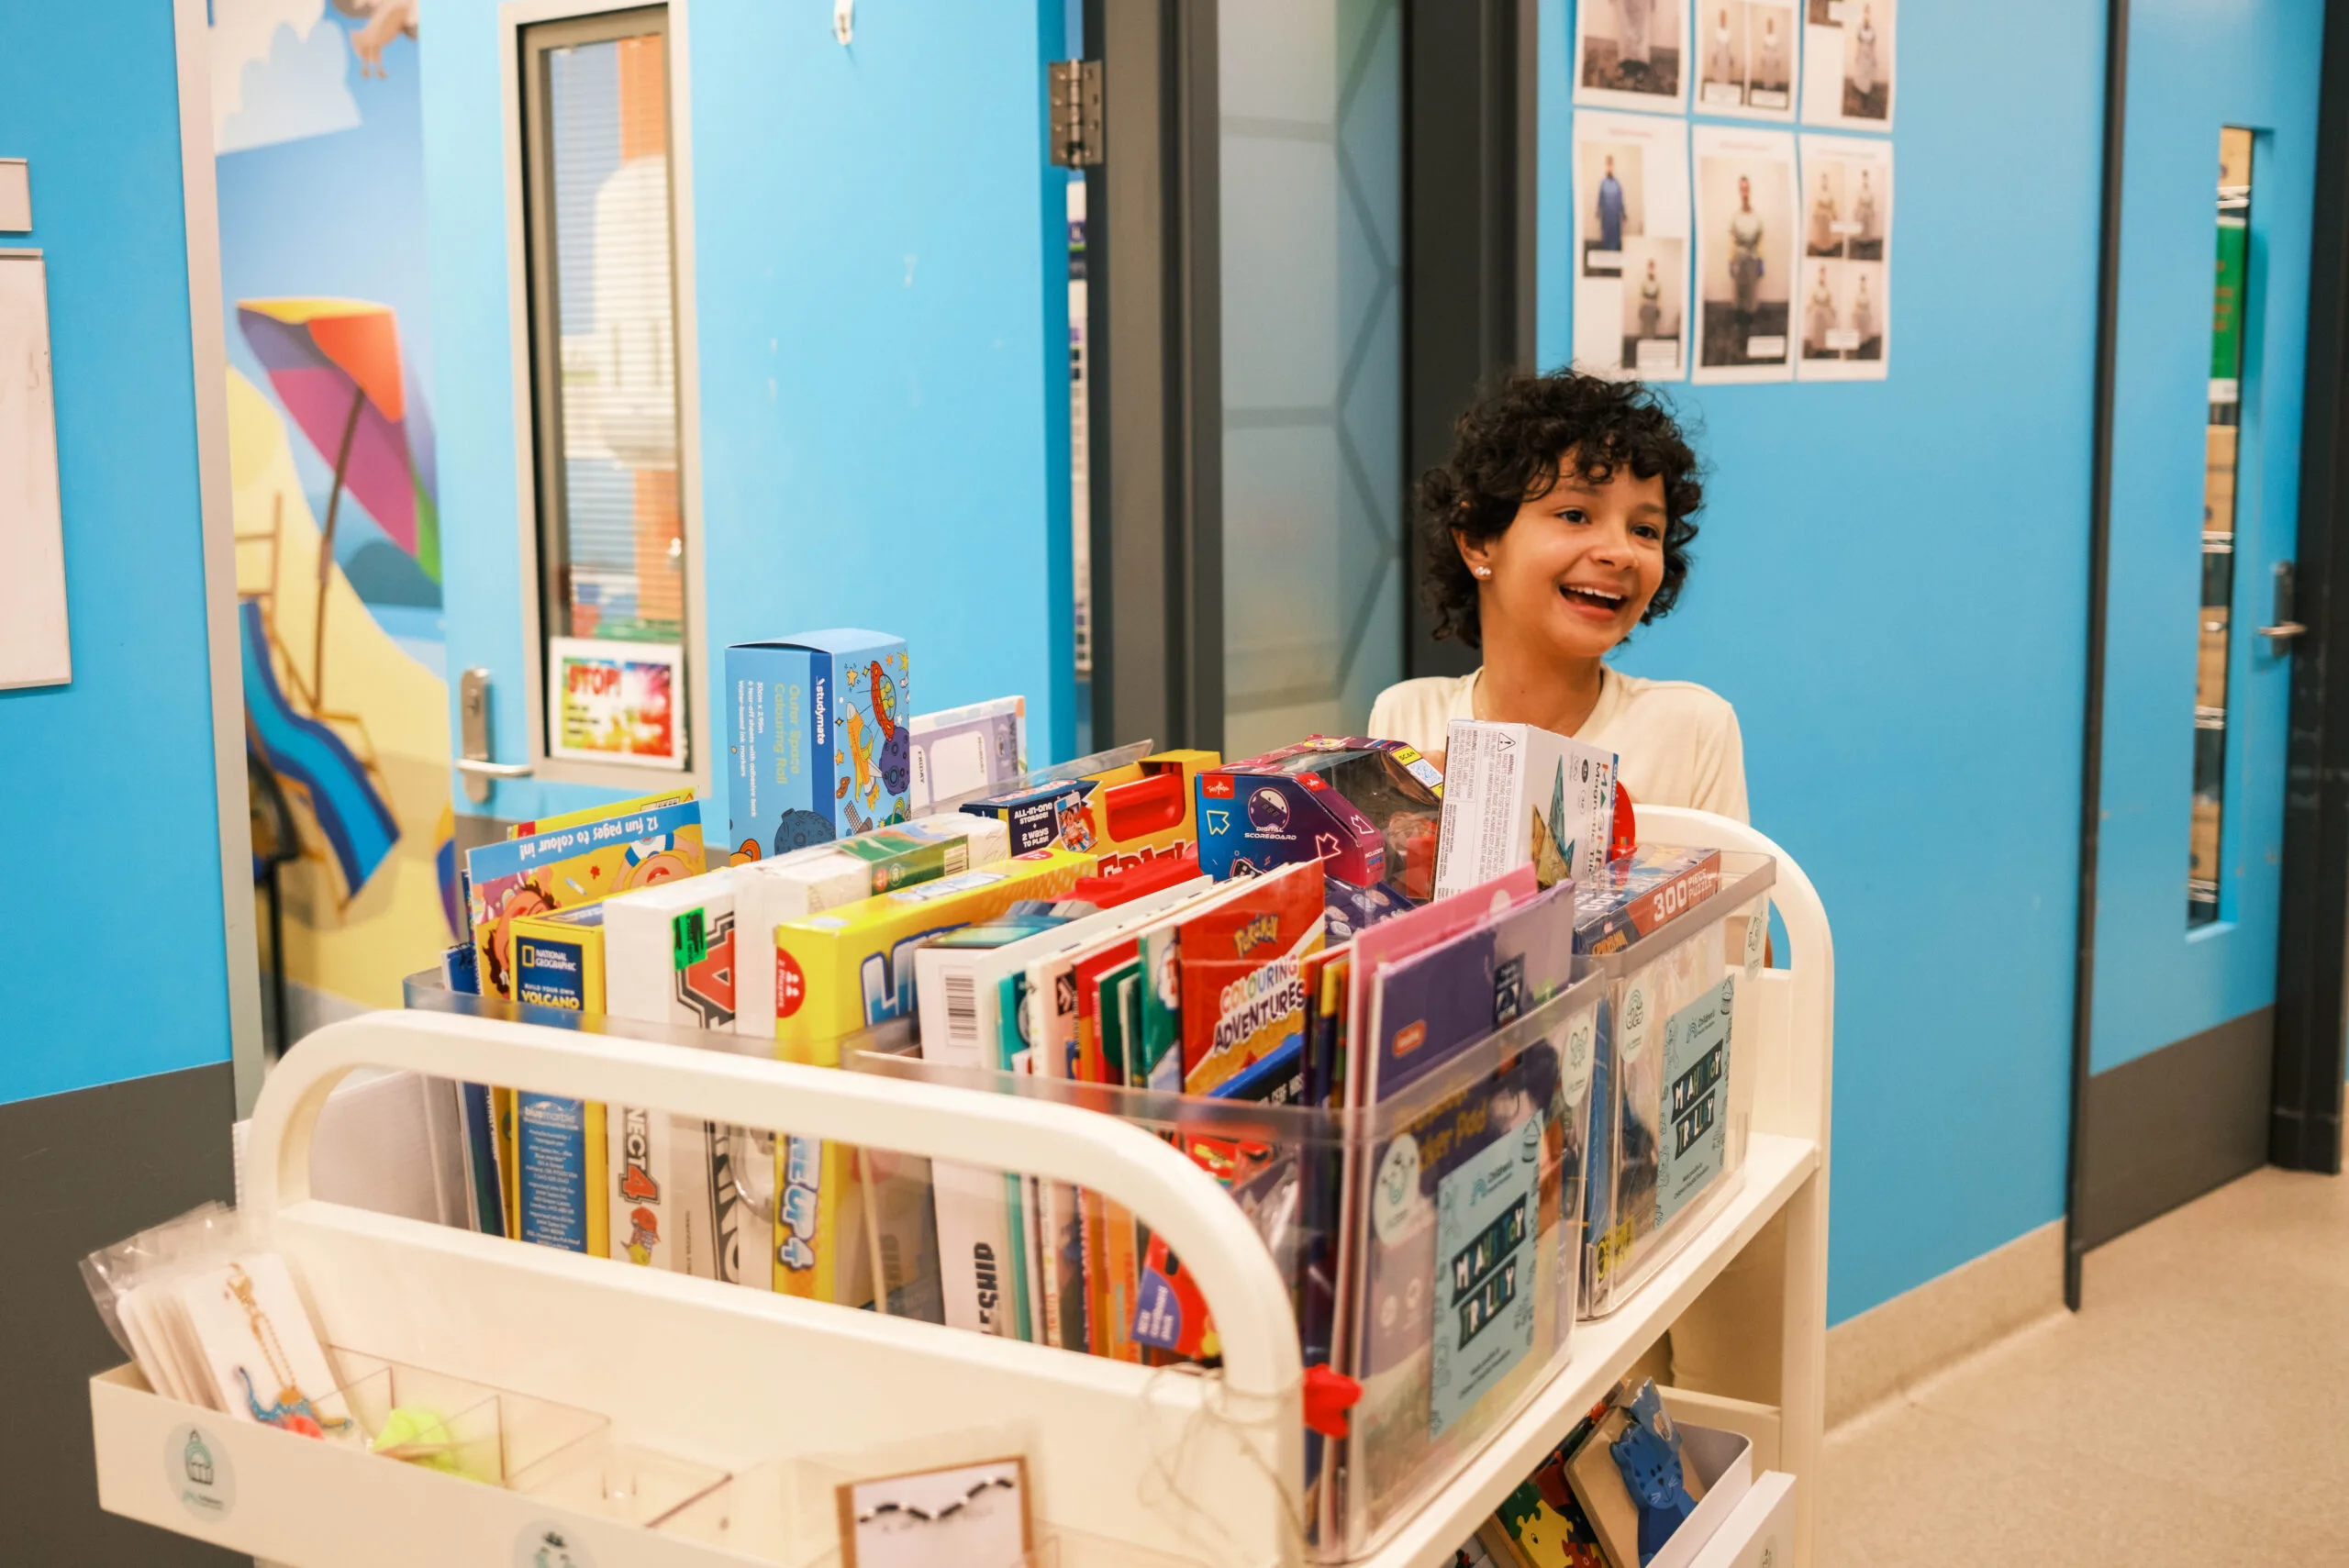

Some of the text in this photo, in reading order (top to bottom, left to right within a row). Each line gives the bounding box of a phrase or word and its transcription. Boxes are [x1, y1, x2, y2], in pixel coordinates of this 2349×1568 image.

[567, 662, 623, 697] STOP!
[774, 684, 786, 784] Colouring Roll
[788, 684, 800, 773] Outer Space
[816, 686, 825, 744] studymate
[1398, 751, 1416, 761] SCAN
[518, 817, 659, 861] 12 fun pages to colour in!
[1022, 833, 1028, 841] 2
[1023, 840, 1031, 848] TO
[1653, 880, 1688, 921] 300
[1688, 879, 1713, 901] PUZZLE
[536, 949, 567, 961] NATIONAL
[536, 959, 576, 972] GEOGRAPHIC
[521, 990, 580, 1010] VOLCANO
[1220, 954, 1299, 1014] COLOURING
[1215, 983, 1305, 1051] ADVENTURES
[1455, 1098, 1487, 1149] Pad
[1677, 1097, 1713, 1153] TROLLEY
[622, 1107, 657, 1198] NECT 4
[781, 1185, 817, 1240] UP
[779, 1237, 815, 1270] 4
